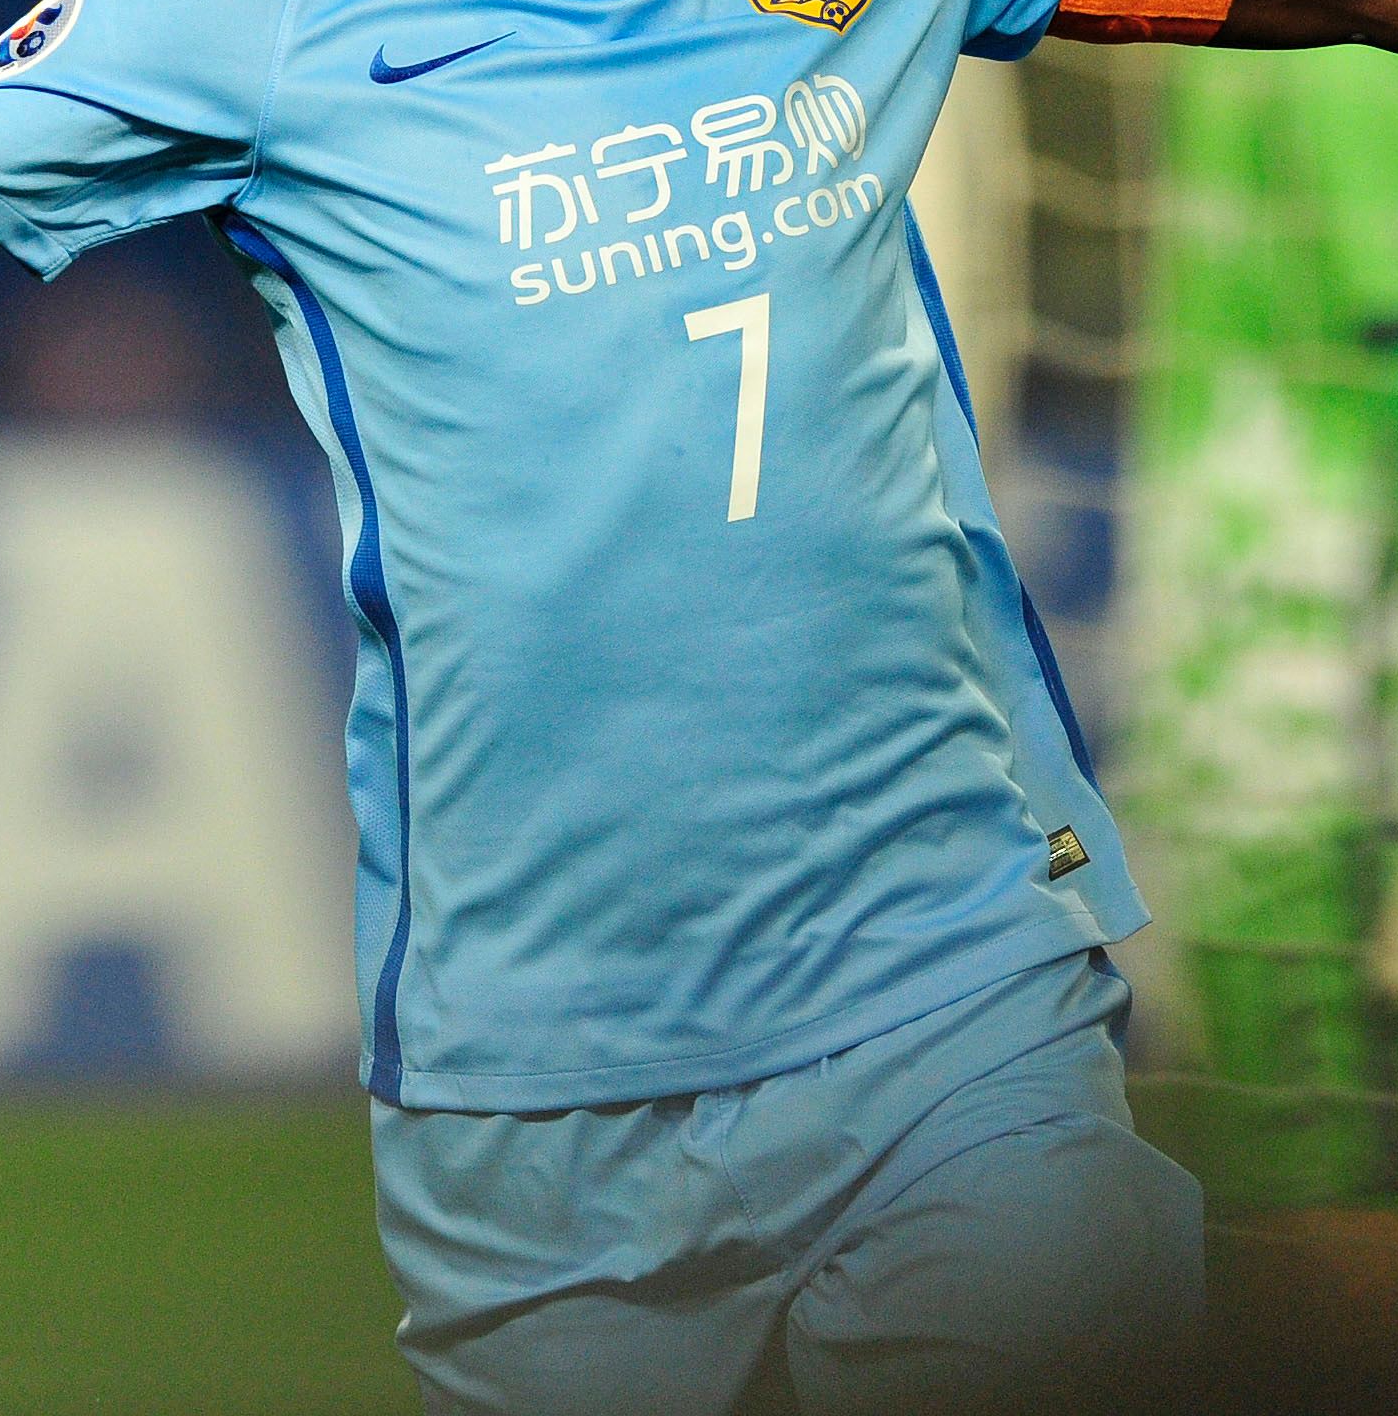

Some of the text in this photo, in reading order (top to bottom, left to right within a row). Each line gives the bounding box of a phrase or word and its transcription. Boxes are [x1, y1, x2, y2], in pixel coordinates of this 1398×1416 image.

[484, 74, 868, 251] 苏宁易购
[512, 170, 884, 306] suning.com
[684, 293, 771, 524] 7
